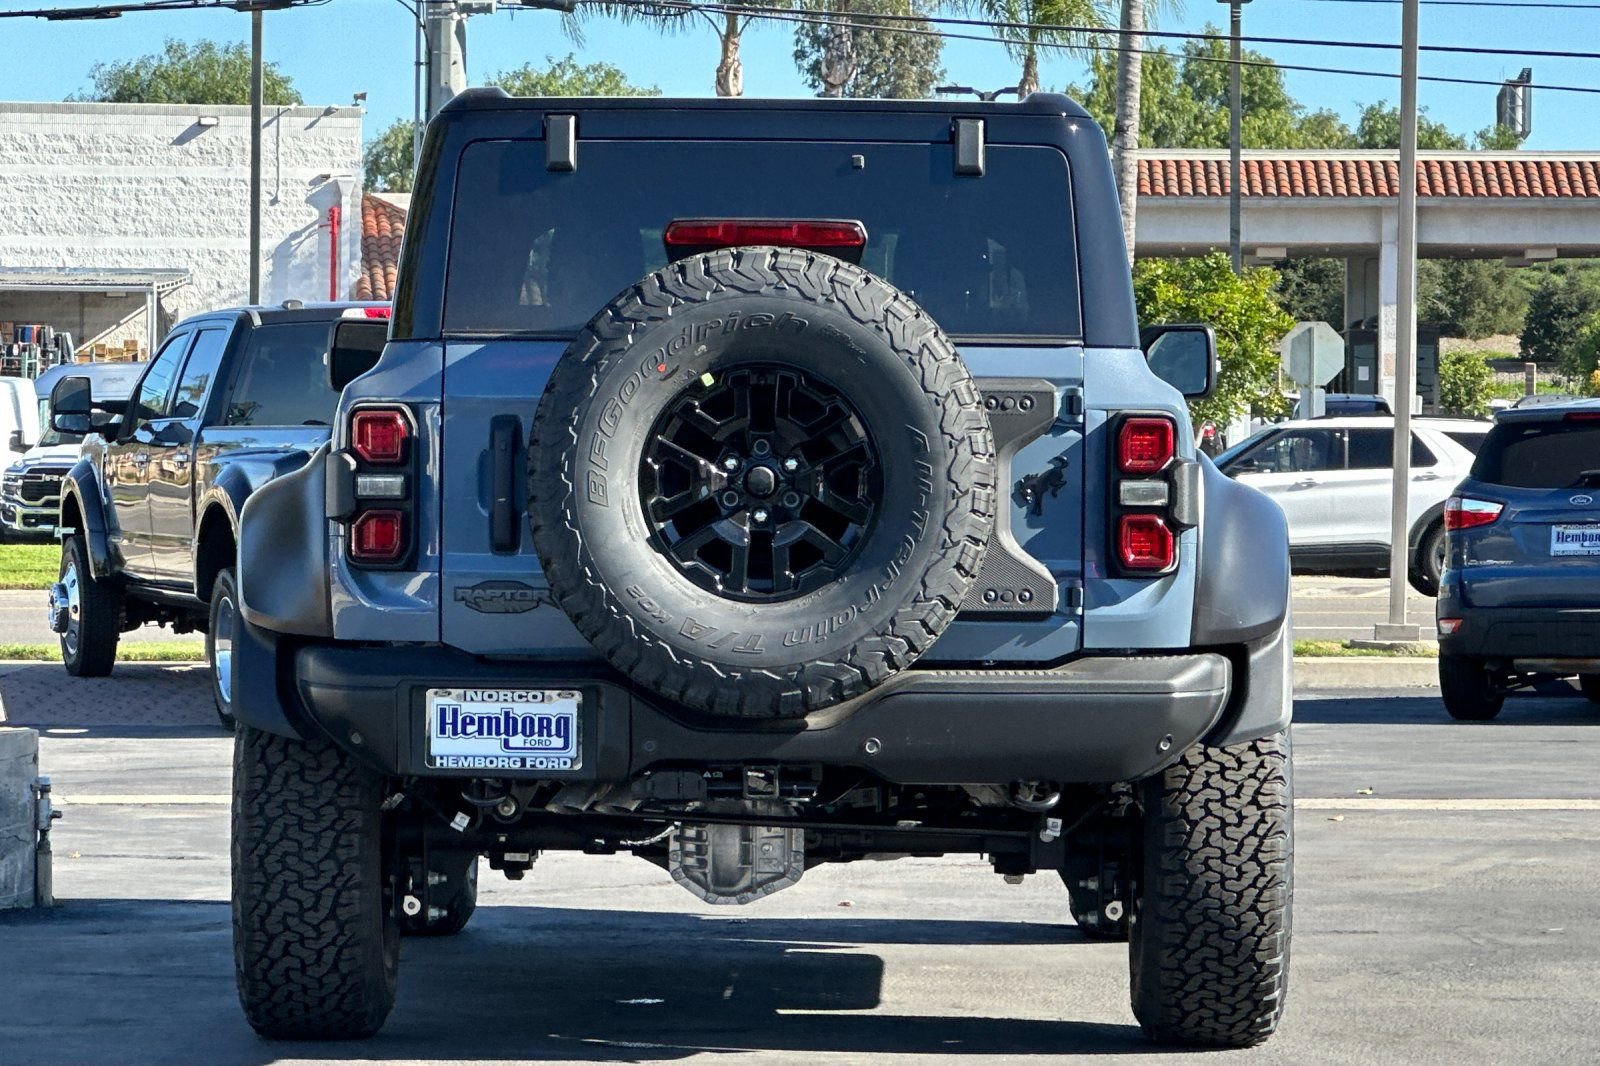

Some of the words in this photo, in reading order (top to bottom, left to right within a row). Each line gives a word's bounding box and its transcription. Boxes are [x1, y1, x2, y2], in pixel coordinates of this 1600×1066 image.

[587, 310, 809, 508] BFGoodrich
[1556, 530, 1600, 543] Hembor
[454, 587, 557, 604] RAPTOR
[625, 584, 674, 624] KO2
[678, 615, 766, 655] T/A
[465, 690, 544, 703] NORCO
[438, 706, 571, 750] Hemborg
[523, 738, 552, 747] FORD
[435, 756, 522, 769] HEMBORG
[526, 757, 572, 769] FORD
